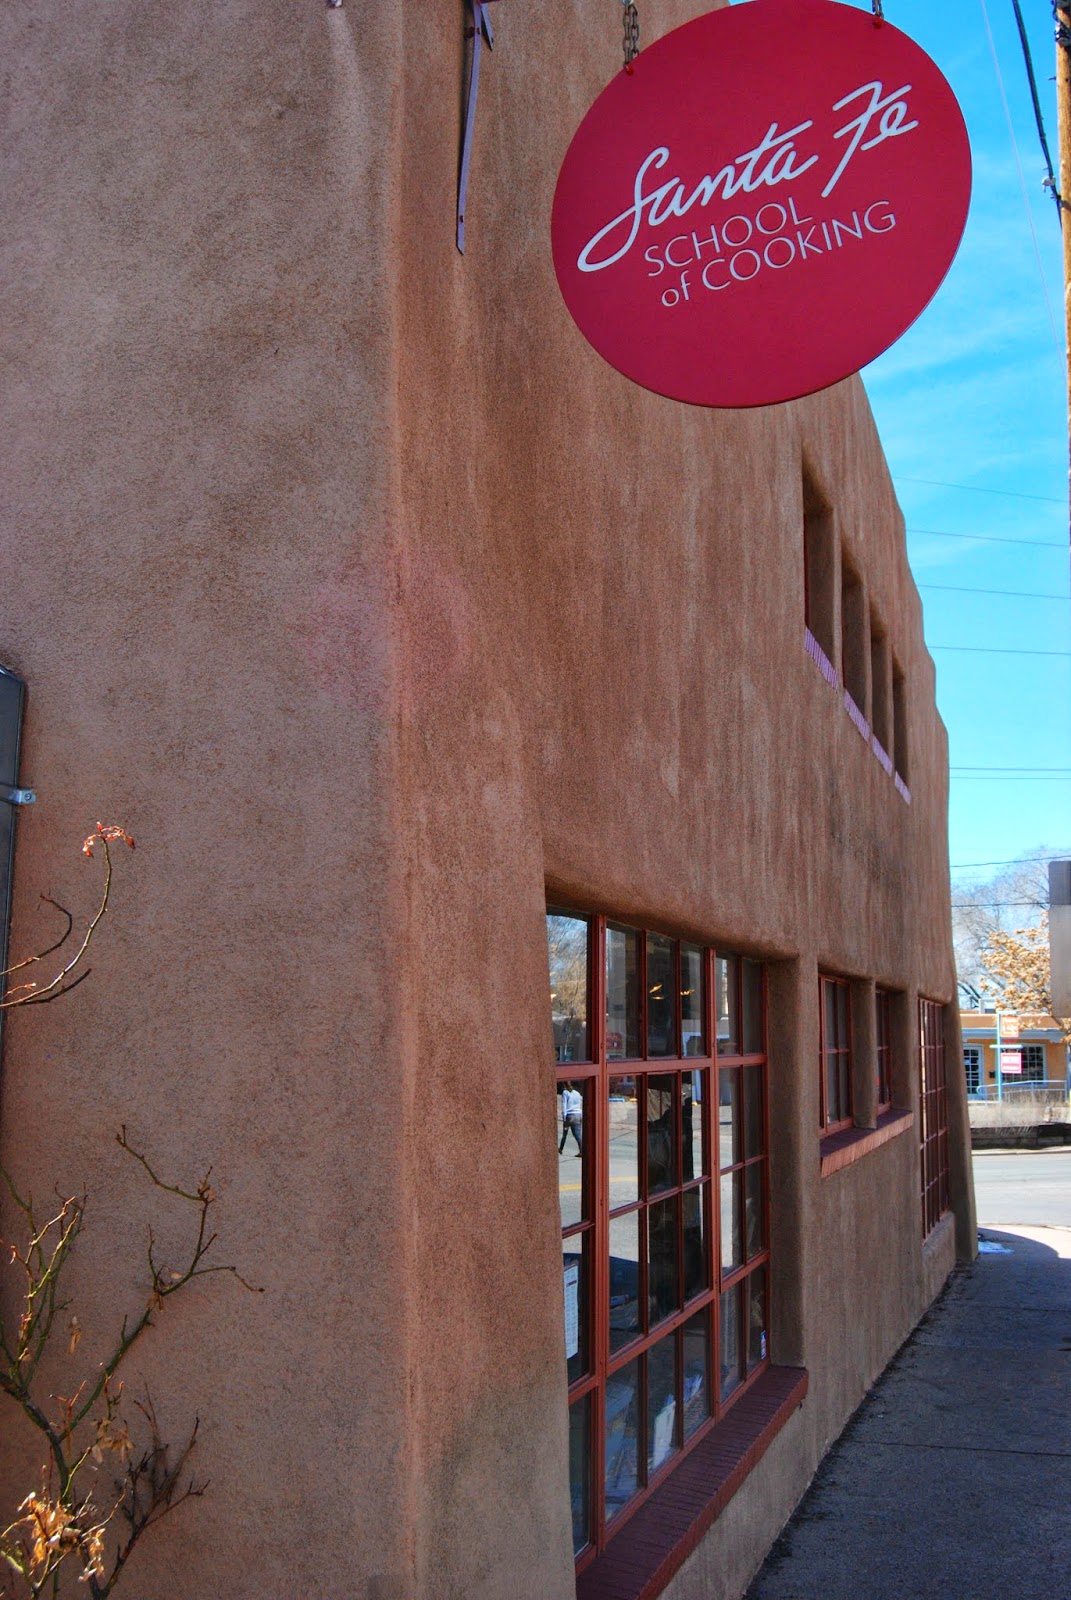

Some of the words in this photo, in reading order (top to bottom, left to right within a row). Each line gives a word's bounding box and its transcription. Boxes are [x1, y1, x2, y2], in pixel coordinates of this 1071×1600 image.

[577, 120, 819, 272] Santa
[821, 81, 919, 199] Fe
[645, 197, 813, 277] SCHOOL
[662, 271, 691, 307] of
[702, 201, 897, 291] COOKING
